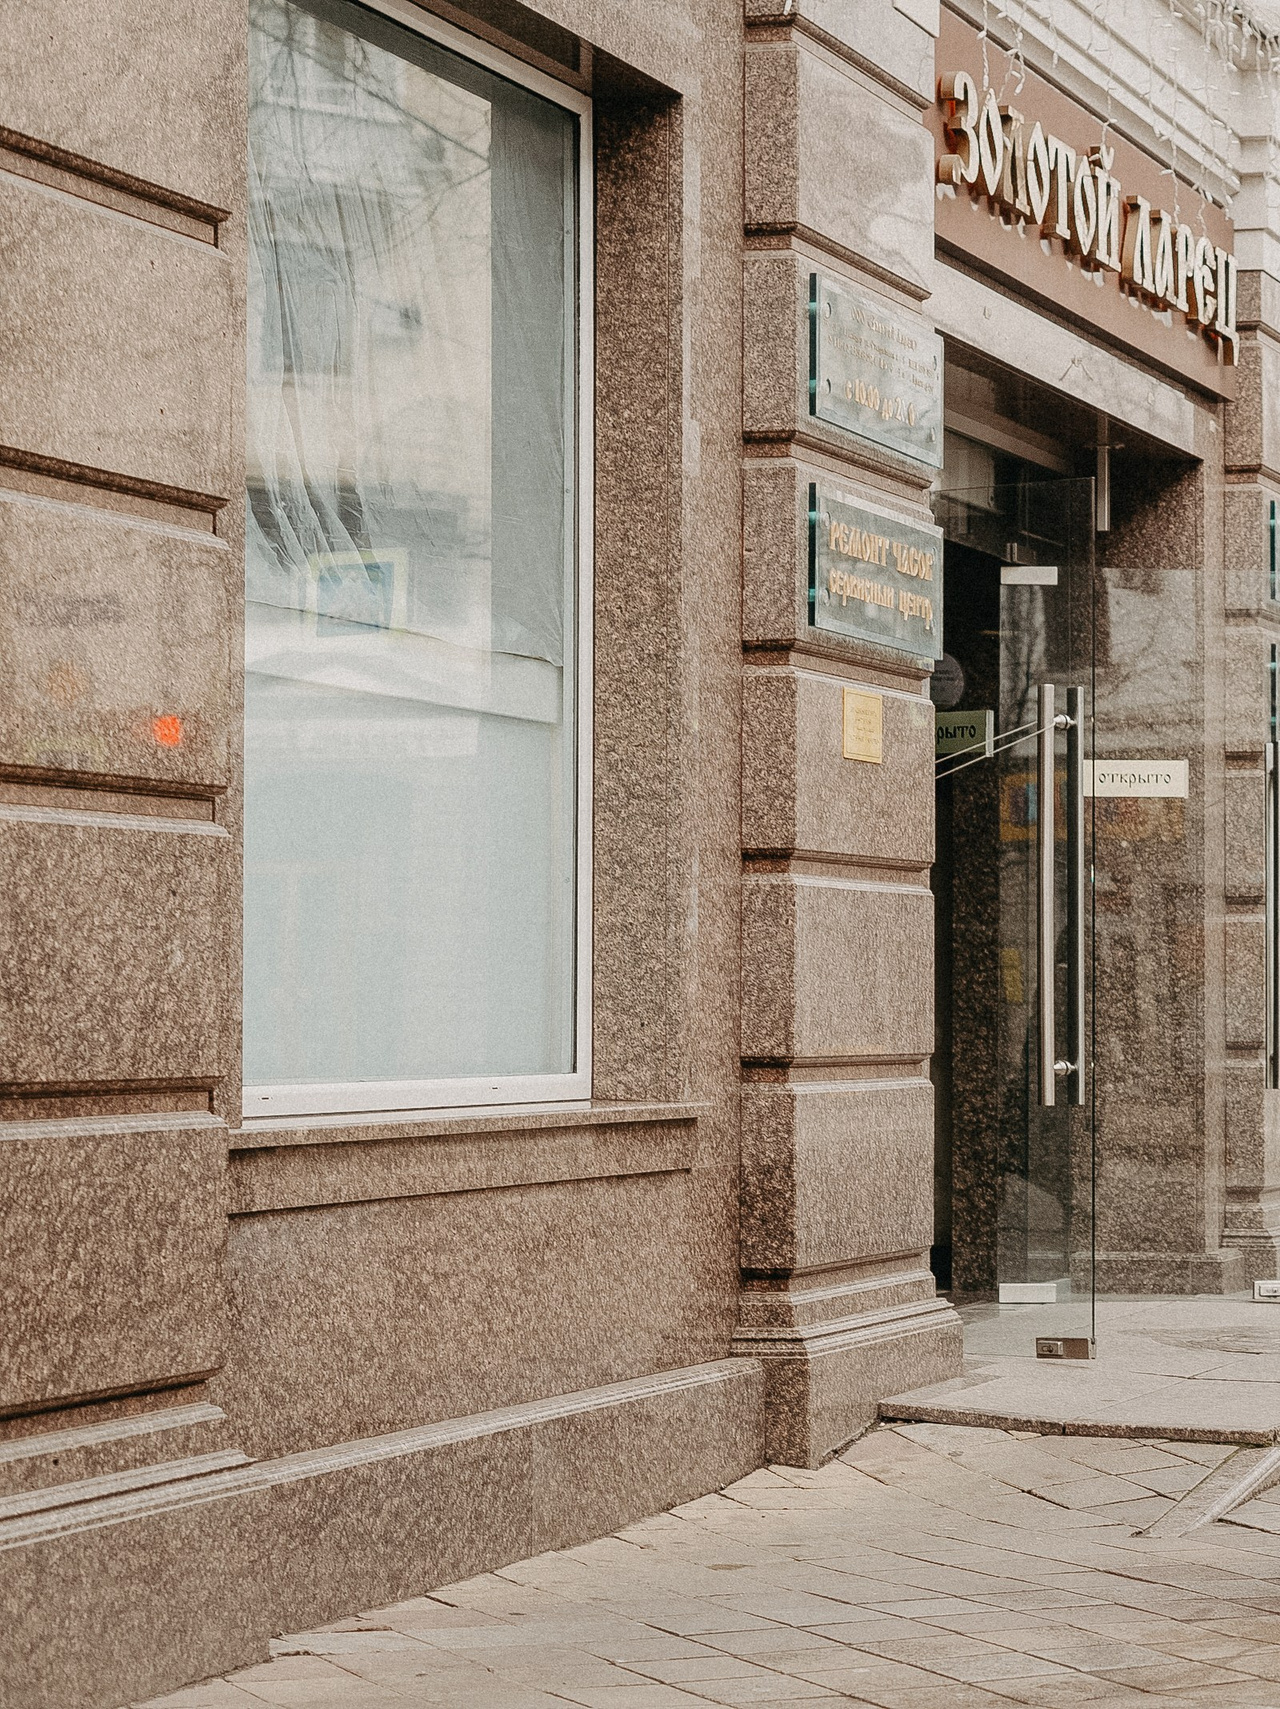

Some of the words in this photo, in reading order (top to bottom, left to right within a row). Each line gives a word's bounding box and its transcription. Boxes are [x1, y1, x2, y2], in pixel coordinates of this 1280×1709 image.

[937, 71, 1122, 273] ЗОЛОТОЙ
[1120, 195, 1240, 367] ЛАРЕЦ
[829, 521, 889, 567] РЕМОНТ
[892, 541, 934, 581] ЧАСОВ
[936, 725, 977, 744] рыто
[1098, 772, 1172, 788] открыто
